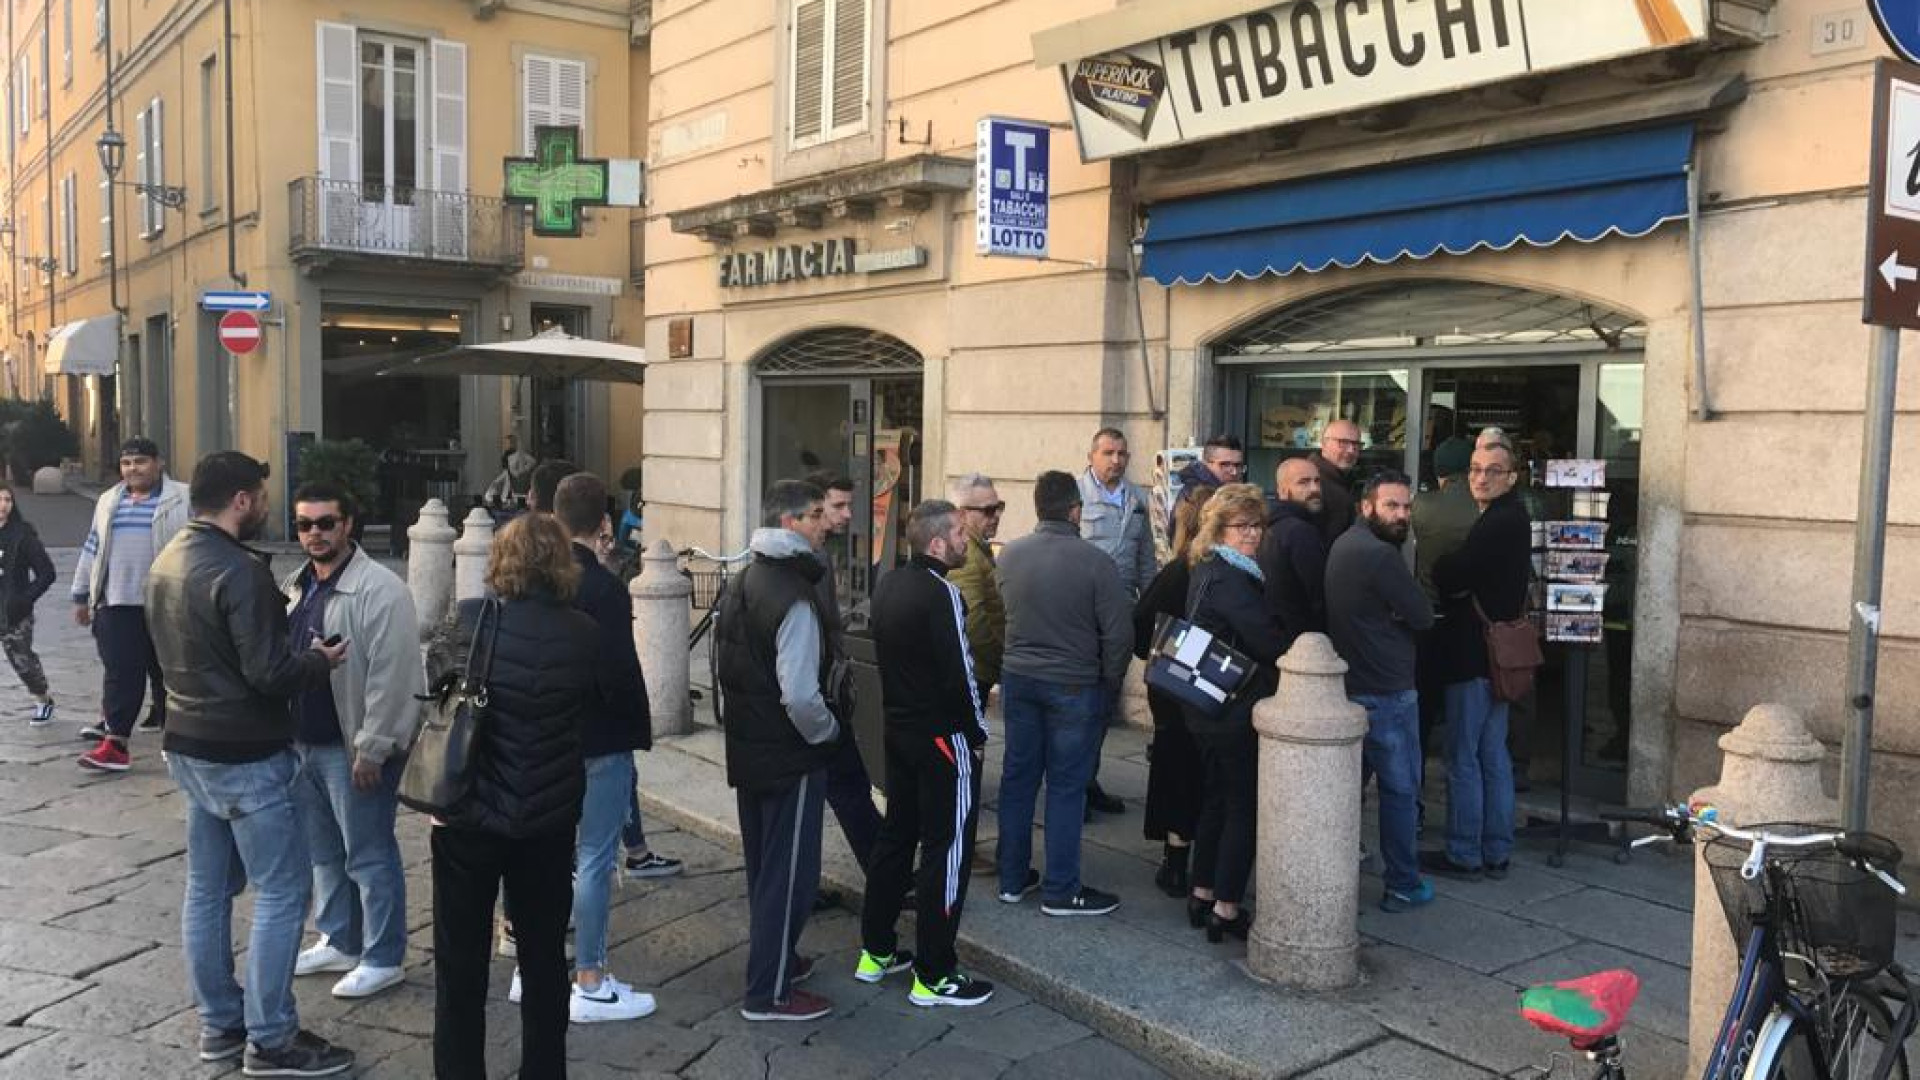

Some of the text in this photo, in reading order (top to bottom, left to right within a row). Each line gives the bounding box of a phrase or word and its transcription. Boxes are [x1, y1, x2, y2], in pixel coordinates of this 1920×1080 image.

[1824, 19, 1854, 43] 30
[1170, 0, 1510, 114] TABACCHI
[1079, 60, 1155, 90] SUPERINOX
[1101, 87, 1138, 103] PLATINO
[977, 123, 987, 238] TABACCHI
[993, 199, 1045, 218] TABACCHI
[991, 227, 1044, 250] LOTTO
[720, 240, 848, 286] FARMACIA
